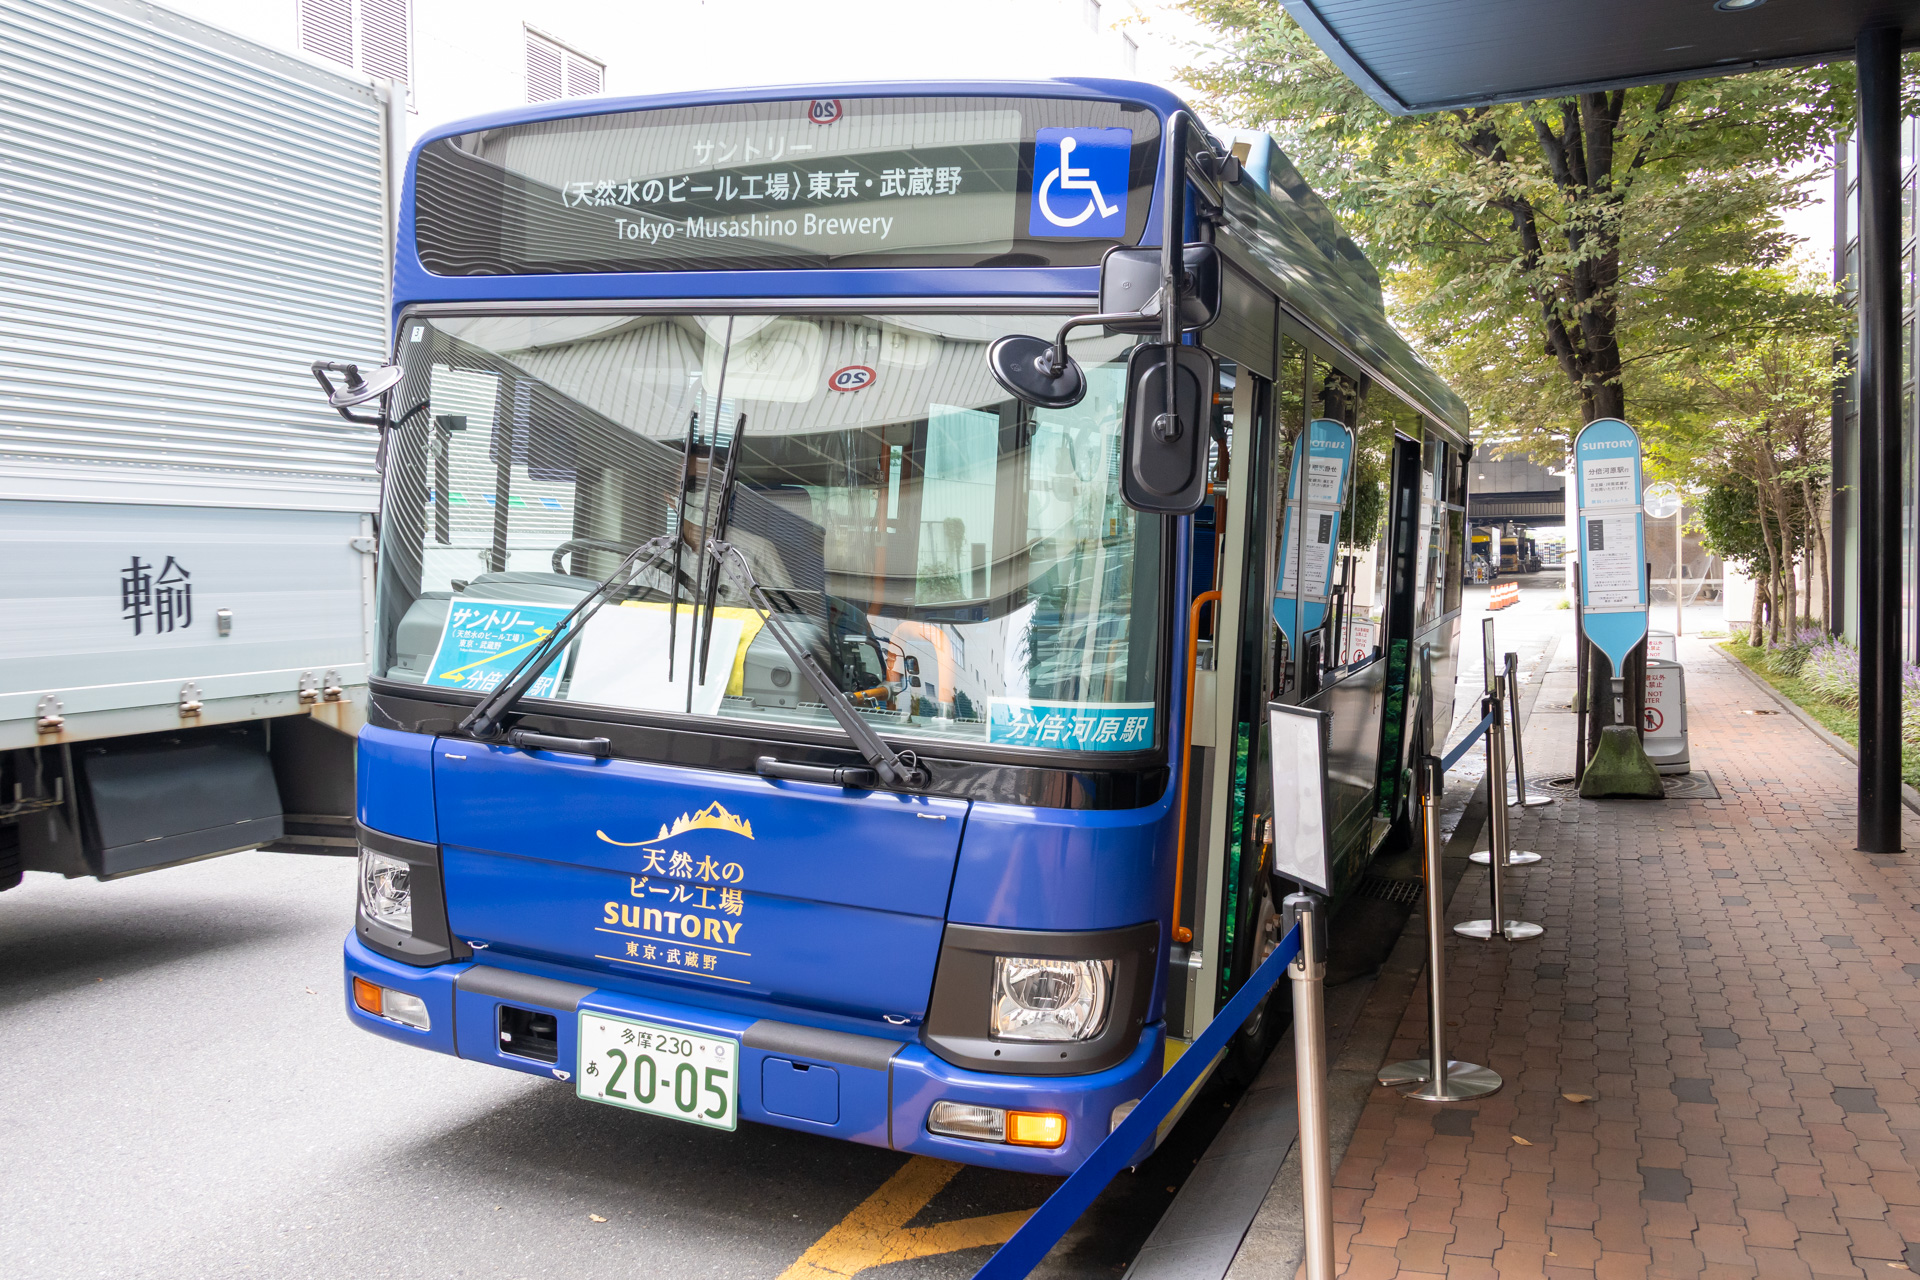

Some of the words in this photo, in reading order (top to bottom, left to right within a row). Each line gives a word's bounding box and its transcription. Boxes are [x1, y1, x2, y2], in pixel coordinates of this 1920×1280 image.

[693, 137, 813, 165] サントリー
[615, 214, 798, 245] Tokyo-Musashino
[804, 212, 894, 241] Brewery
[1582, 440, 1634, 451] SUNTORY
[120, 555, 193, 636] 輸
[452, 608, 535, 632] サントリー
[458, 639, 502, 651] 東京・武蔵野
[462, 670, 554, 697] 分倍駅
[1006, 713, 1149, 744] 分倍河原駅
[641, 848, 745, 884] 天然水の
[630, 876, 745, 917] ビール工場
[603, 901, 743, 945] SUNTORY
[625, 941, 718, 971] 東京・武蔵野
[585, 1060, 600, 1078] あ
[605, 1048, 729, 1119] 20-05
